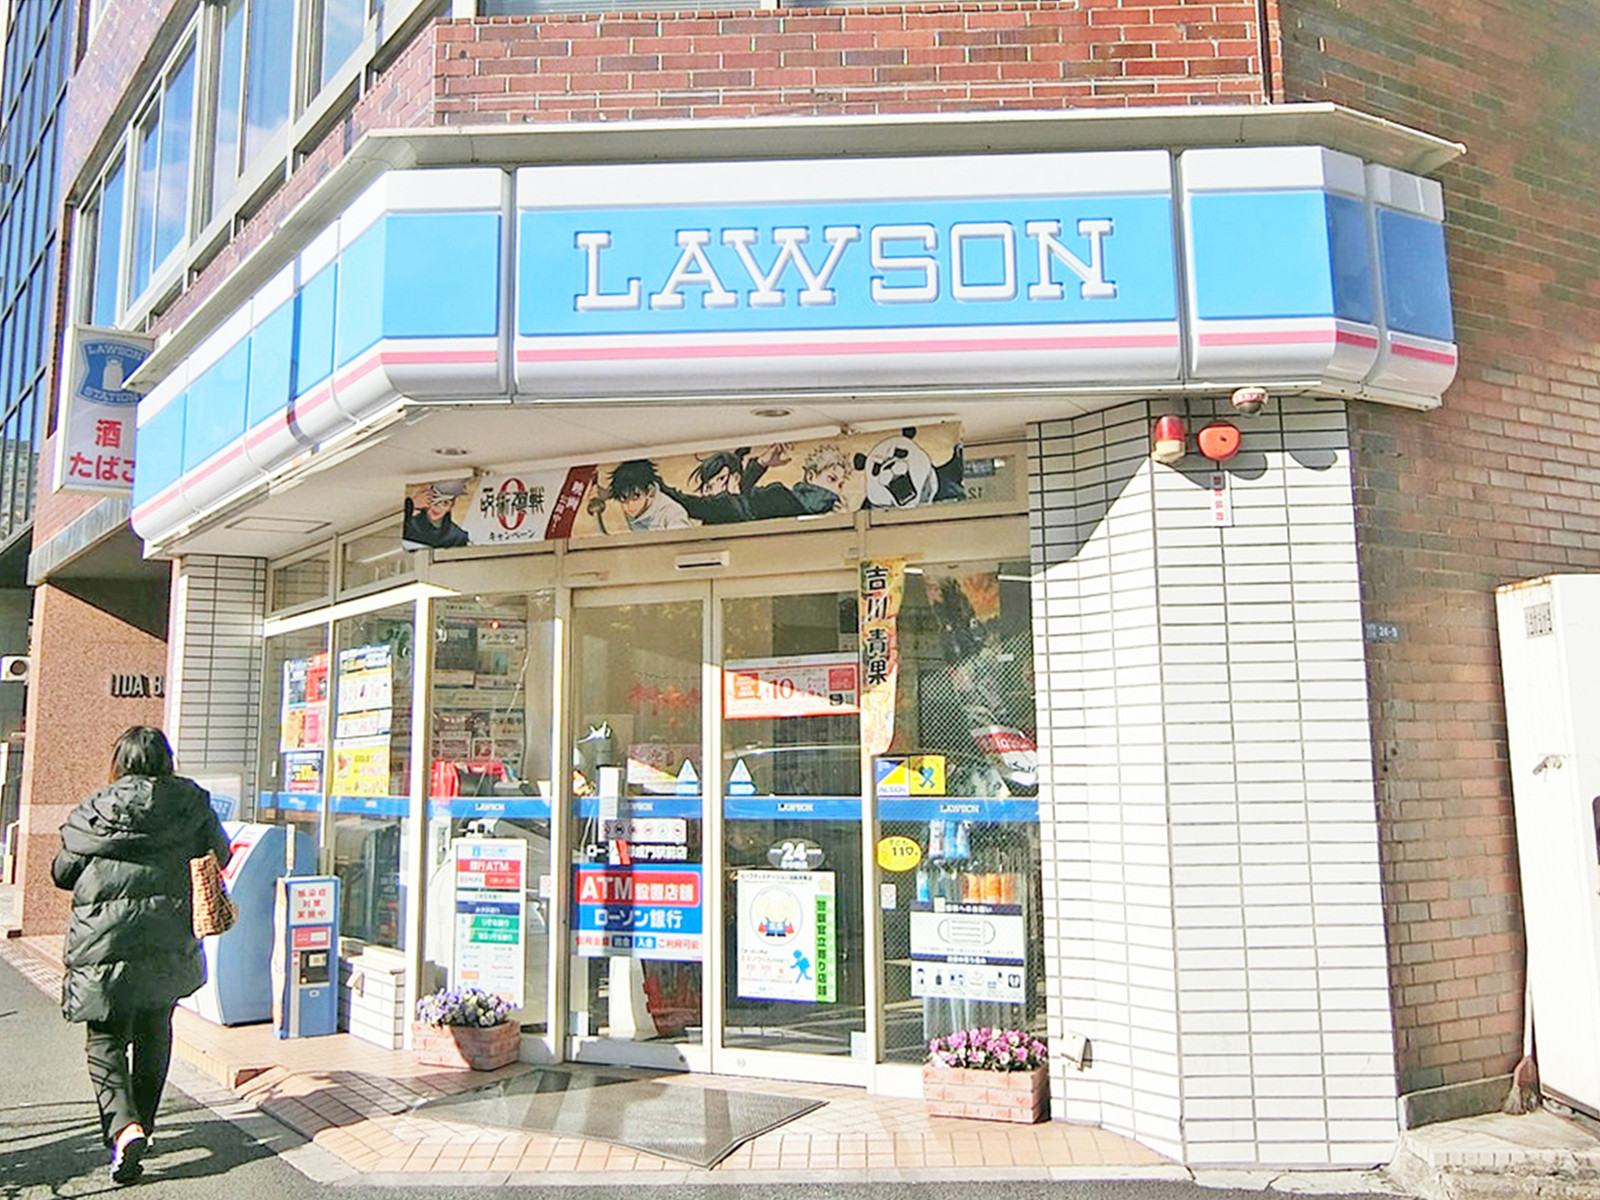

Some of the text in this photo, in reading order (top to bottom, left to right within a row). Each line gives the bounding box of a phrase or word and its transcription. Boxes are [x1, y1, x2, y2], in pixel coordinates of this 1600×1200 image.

[574, 217, 1117, 312] LAWSON
[95, 419, 122, 449] 酒
[69, 451, 136, 483] たばこ
[489, 529, 536, 541] キャンペーン
[865, 565, 889, 685] 吉川青果
[940, 803, 980, 813] LAWSON
[781, 841, 807, 861] 24
[594, 909, 684, 929] ローソン銀行
